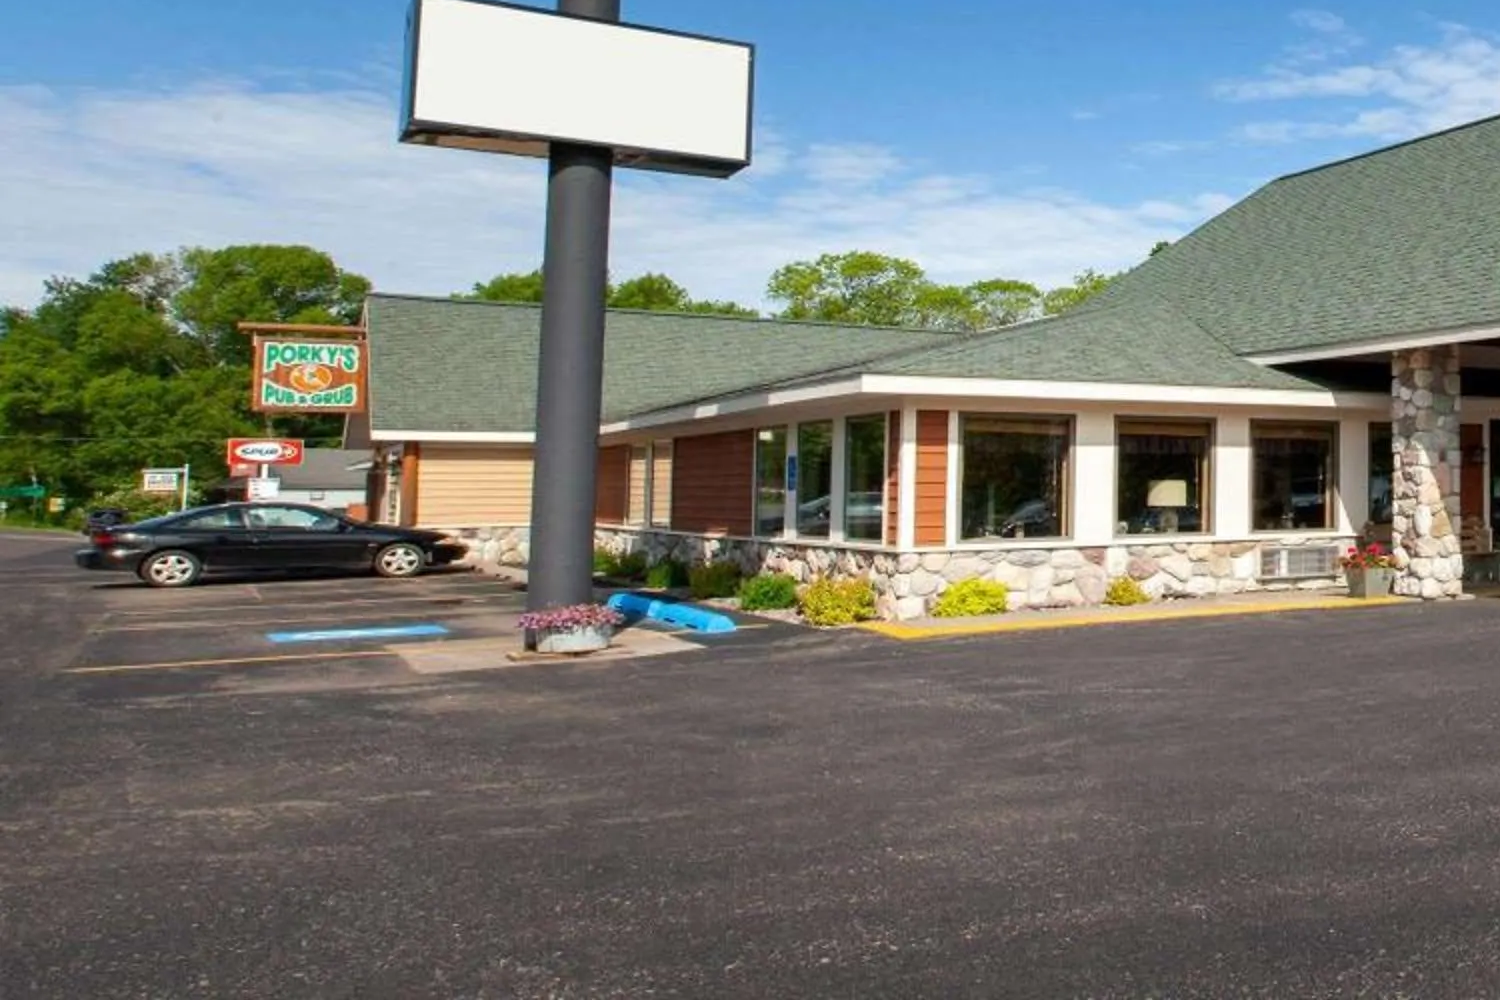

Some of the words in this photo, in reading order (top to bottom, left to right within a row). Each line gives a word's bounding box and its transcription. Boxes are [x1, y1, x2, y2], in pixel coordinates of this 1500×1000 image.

[265, 344, 358, 372] PORKY'S
[263, 382, 296, 405] PUB
[310, 385, 355, 405] GRUB
